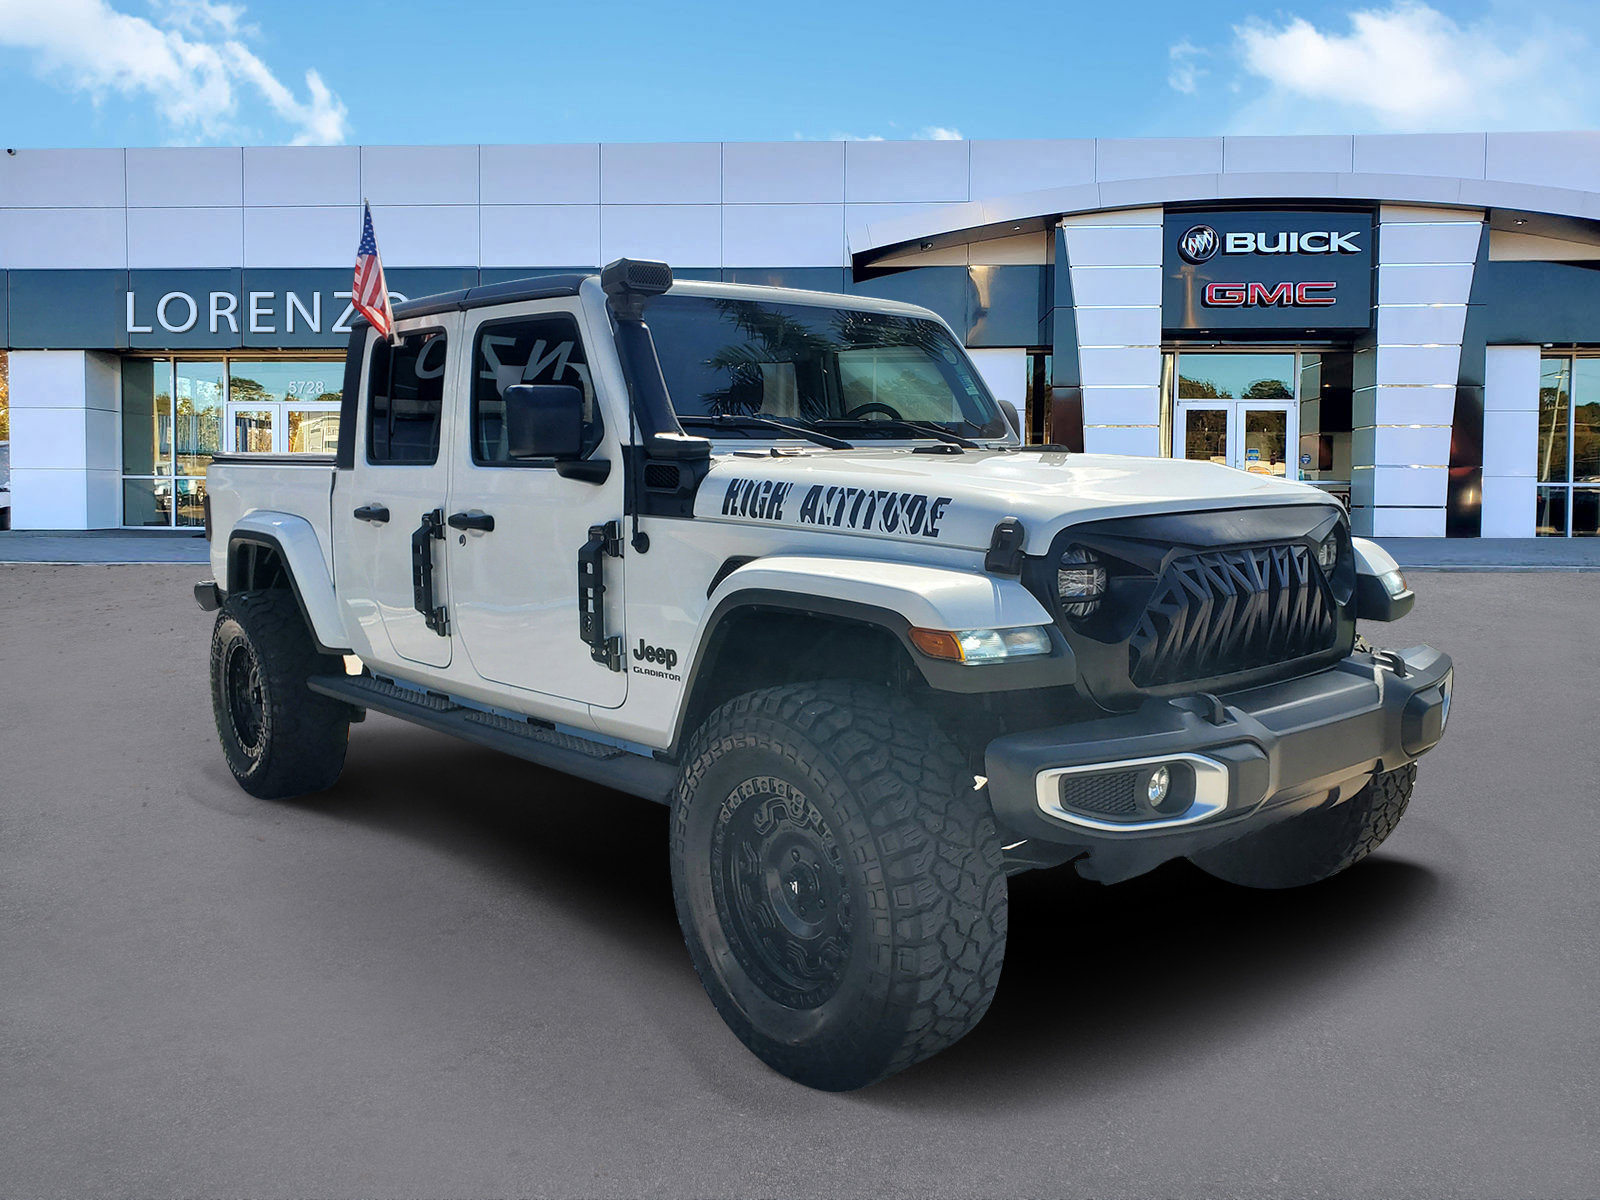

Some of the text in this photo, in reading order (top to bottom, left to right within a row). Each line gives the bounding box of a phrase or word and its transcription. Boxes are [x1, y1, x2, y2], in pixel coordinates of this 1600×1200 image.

[1226, 231, 1362, 252] BUICK
[1206, 281, 1337, 305] GMC
[126, 291, 408, 333] LORENZ
[288, 381, 325, 394] 5728
[721, 478, 952, 538] HIGH ALTITUDE
[633, 638, 678, 670] Jeep
[633, 666, 681, 682] GLADIATOR
